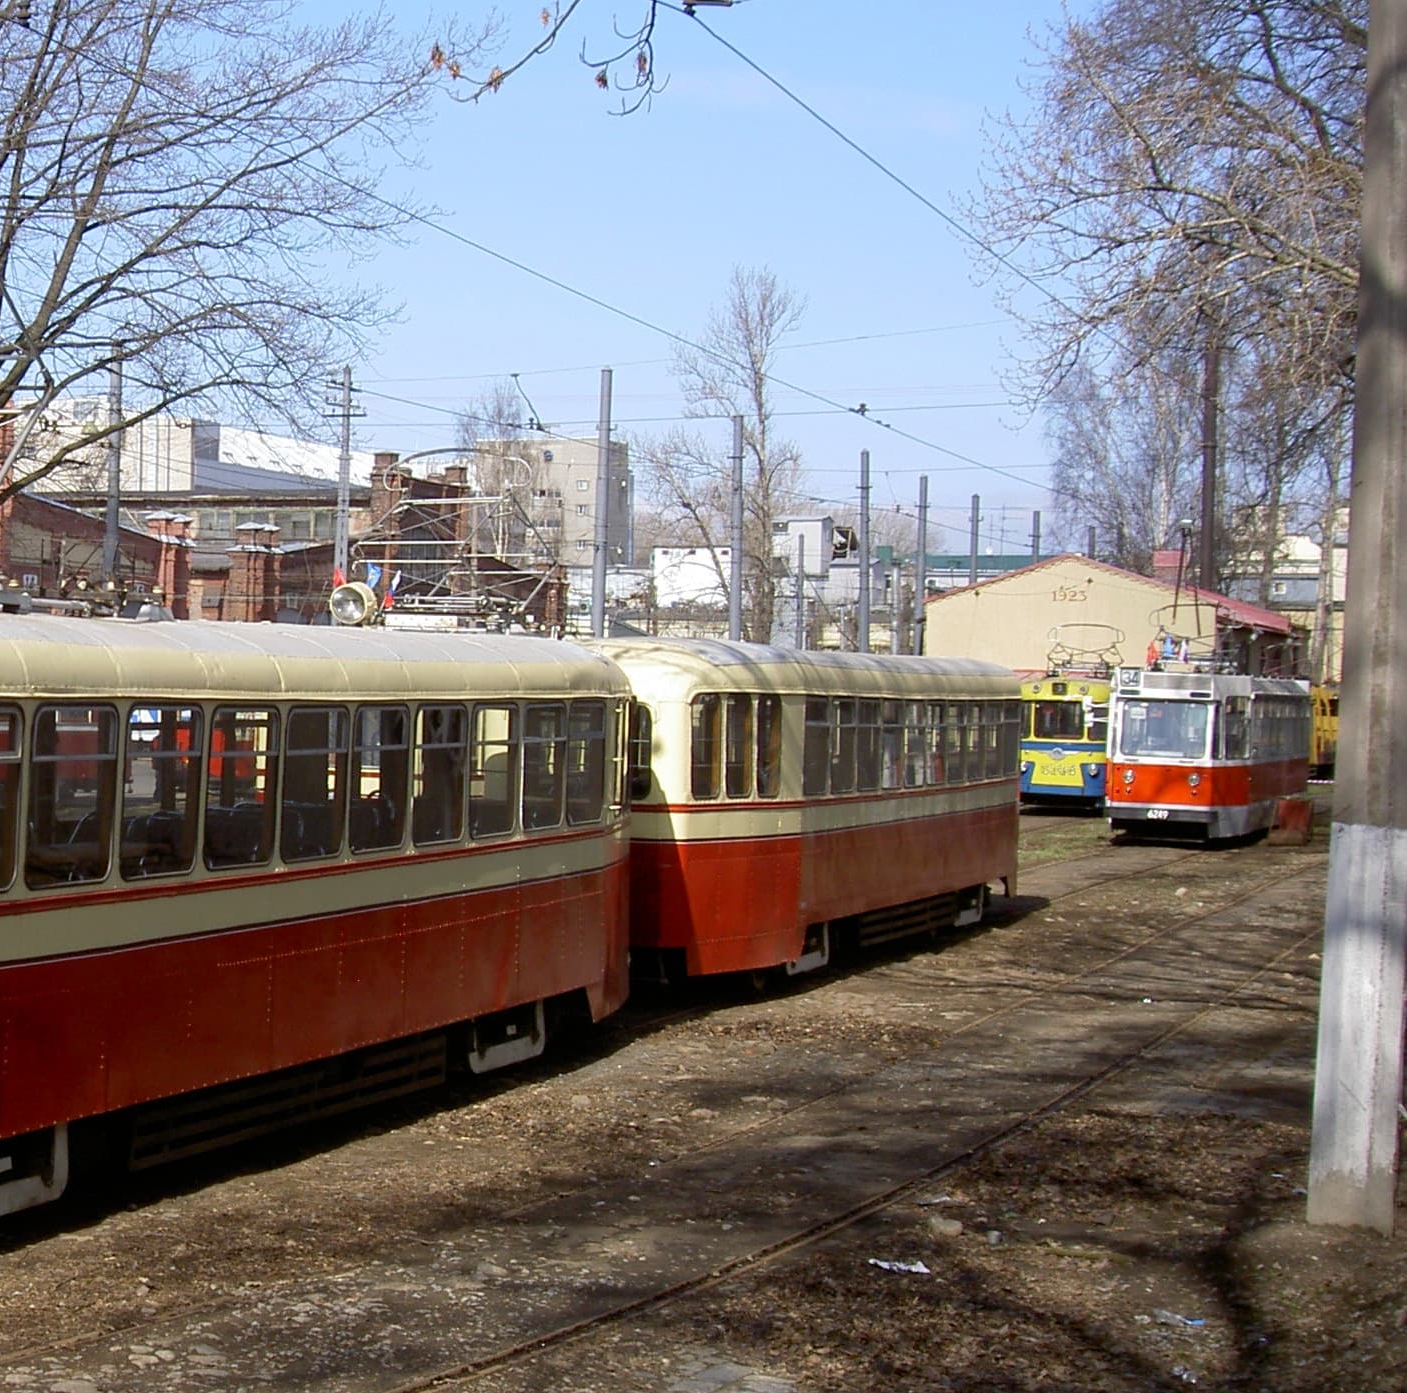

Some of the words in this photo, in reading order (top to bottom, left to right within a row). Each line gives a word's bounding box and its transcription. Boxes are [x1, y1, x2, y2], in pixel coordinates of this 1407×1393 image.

[1052, 590, 1088, 602] 1923
[1123, 670, 1139, 685] 34
[1147, 809, 1169, 820] 6249
